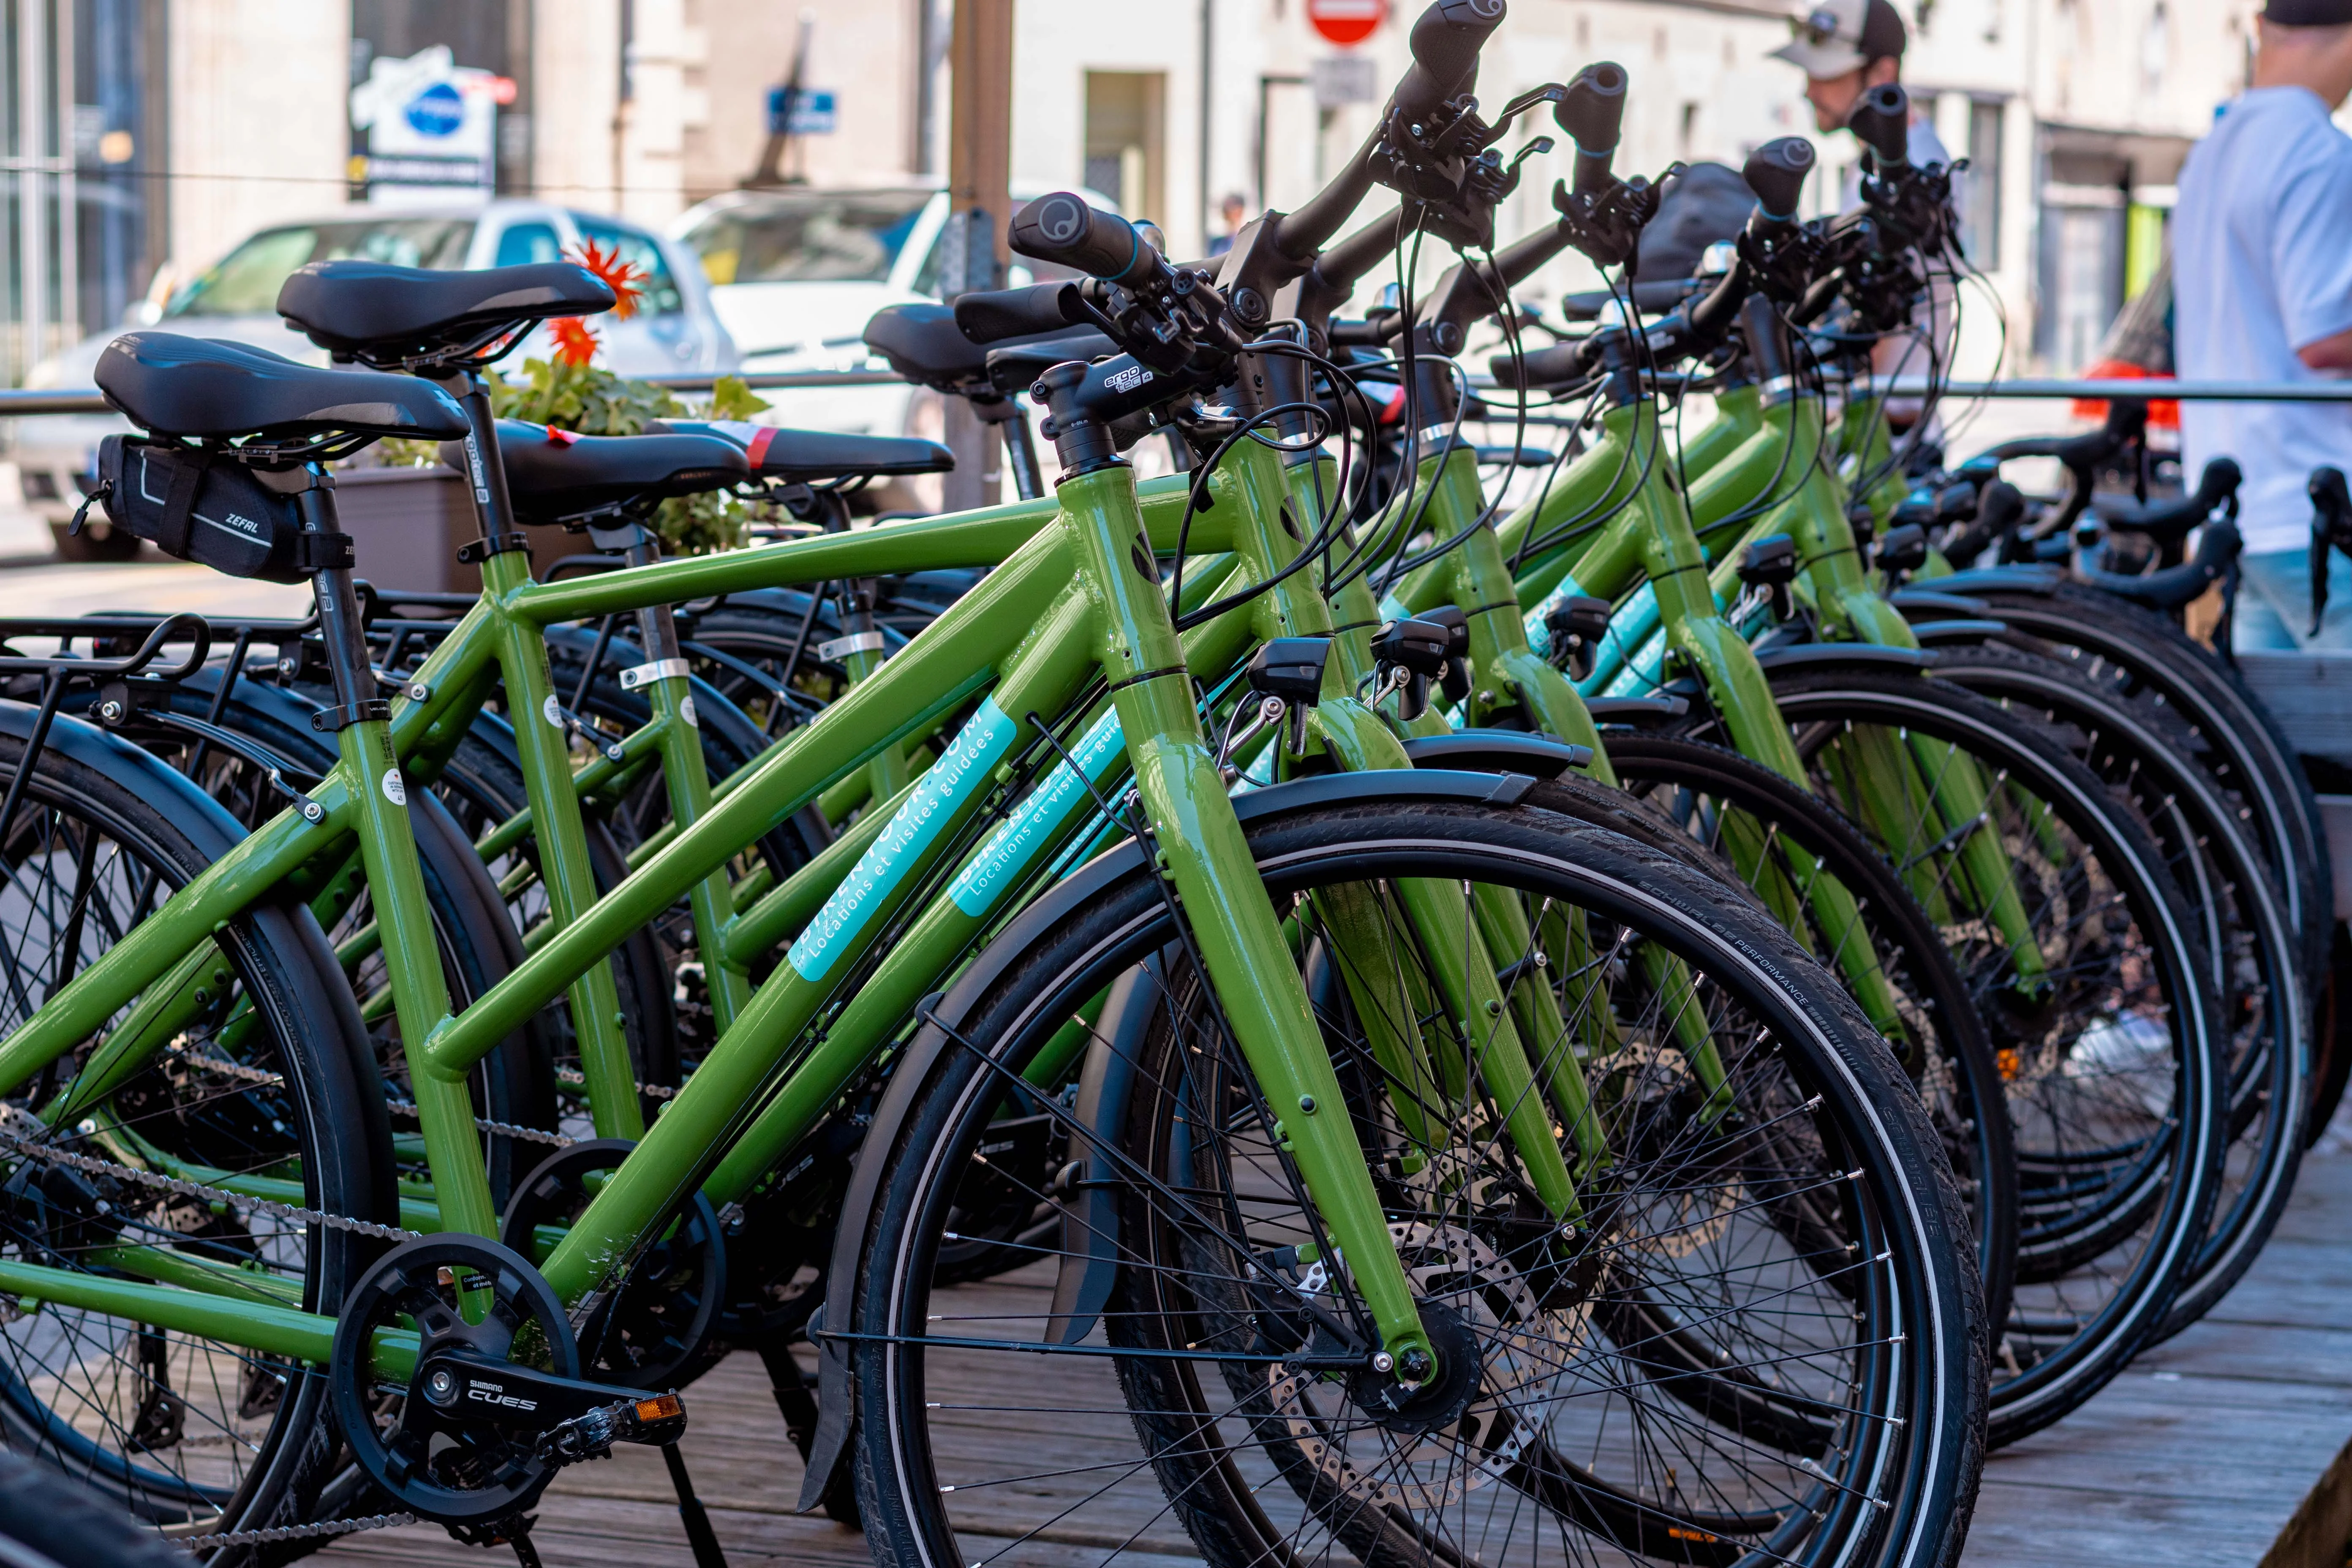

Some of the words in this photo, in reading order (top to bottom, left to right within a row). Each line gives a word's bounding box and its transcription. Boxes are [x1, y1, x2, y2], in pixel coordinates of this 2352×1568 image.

[1104, 366, 1139, 387] ergo
[806, 879, 875, 958] Locations
[871, 855, 893, 877] et
[890, 796, 941, 855] visites
[937, 726, 996, 797] guidées
[968, 824, 1032, 896] Locations
[1030, 805, 1049, 824] et
[234, 923, 266, 972] EFFICIENCY
[1735, 940, 1809, 1006] PERFORMANCE
[468, 1389, 537, 1411] CUES
[470, 1380, 503, 1393] SHIMANO
